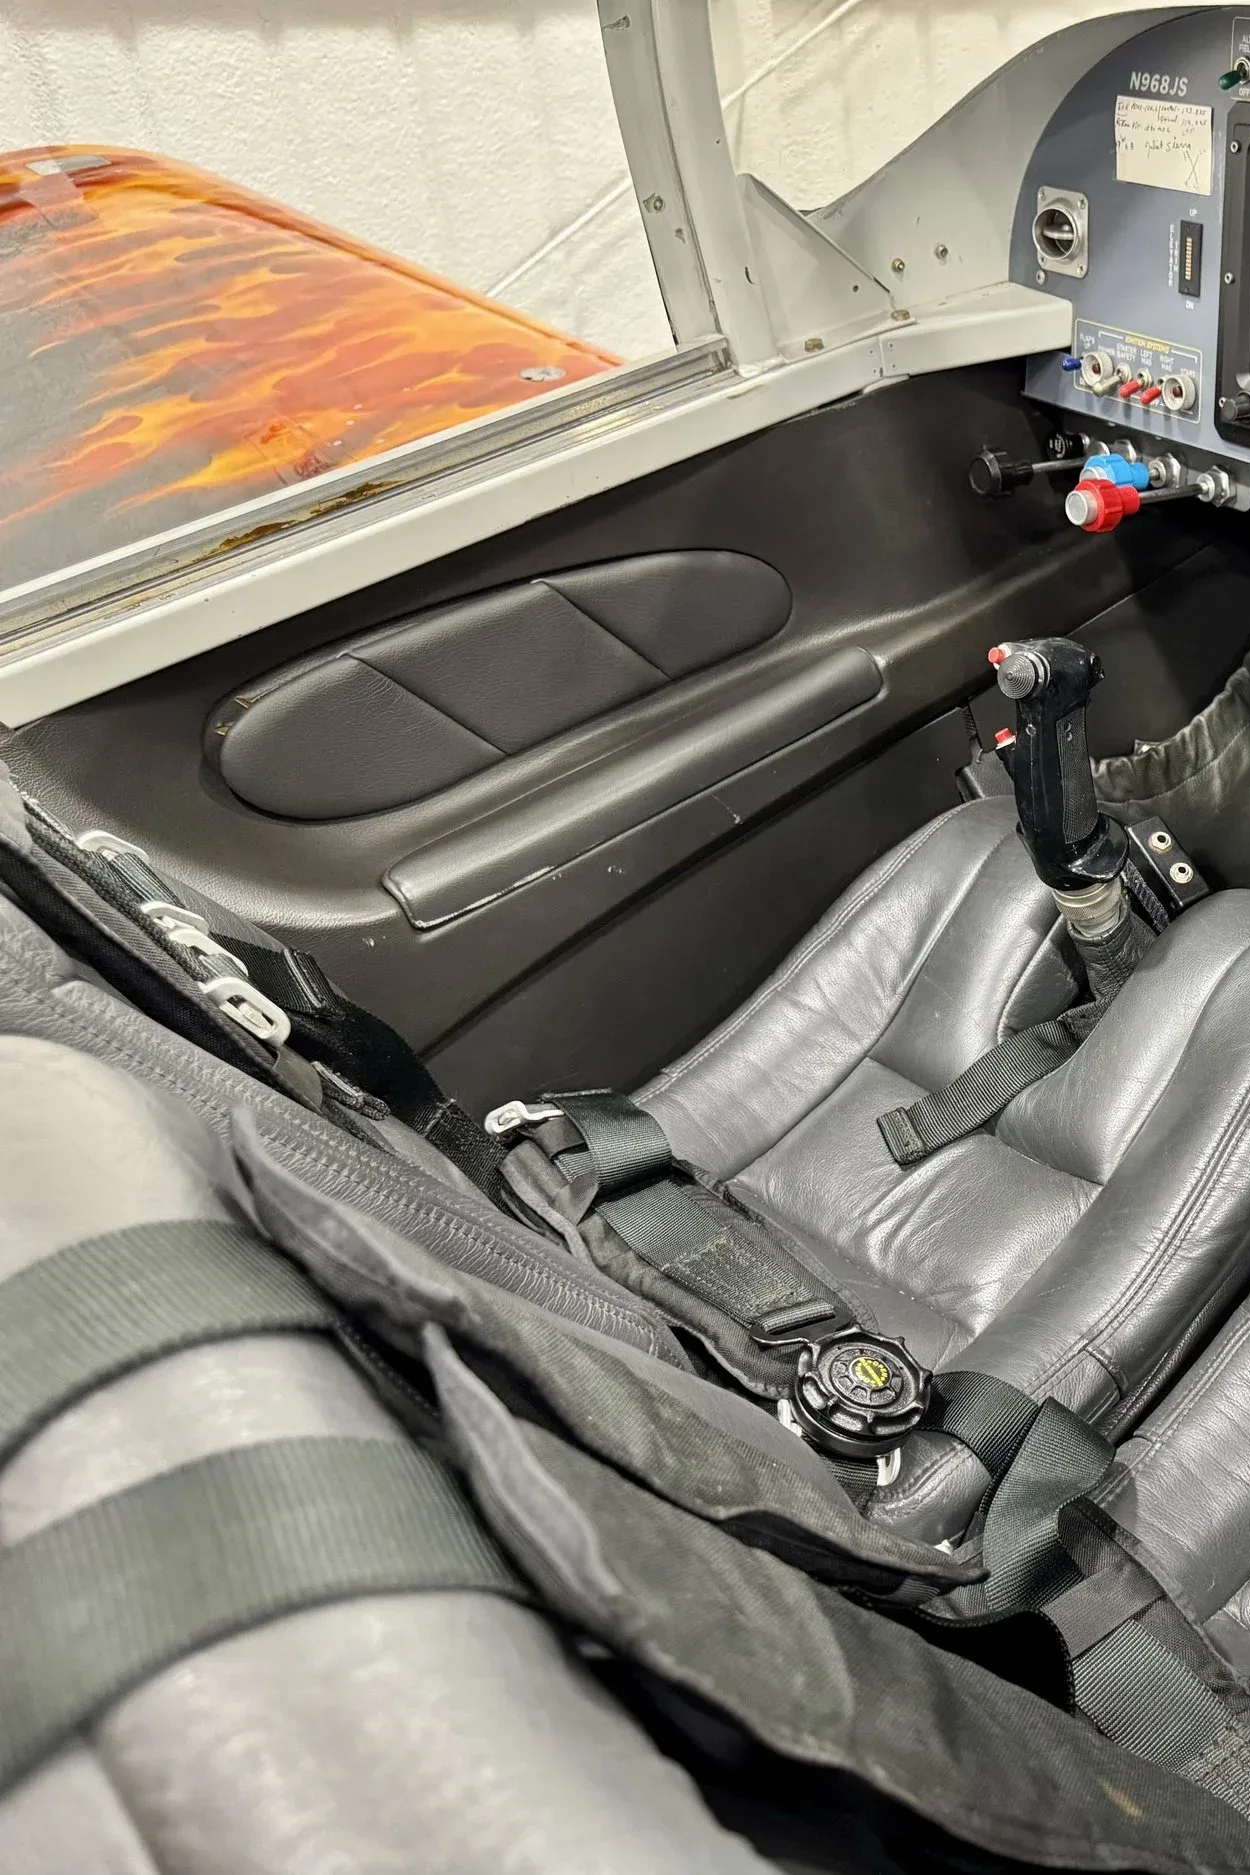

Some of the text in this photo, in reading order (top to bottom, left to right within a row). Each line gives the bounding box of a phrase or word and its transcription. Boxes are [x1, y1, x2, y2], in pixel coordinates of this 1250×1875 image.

[1129, 71, 1189, 97] N968JS
[1239, 88, 1250, 97] OFF
[1140, 349, 1153, 358] LEFT
